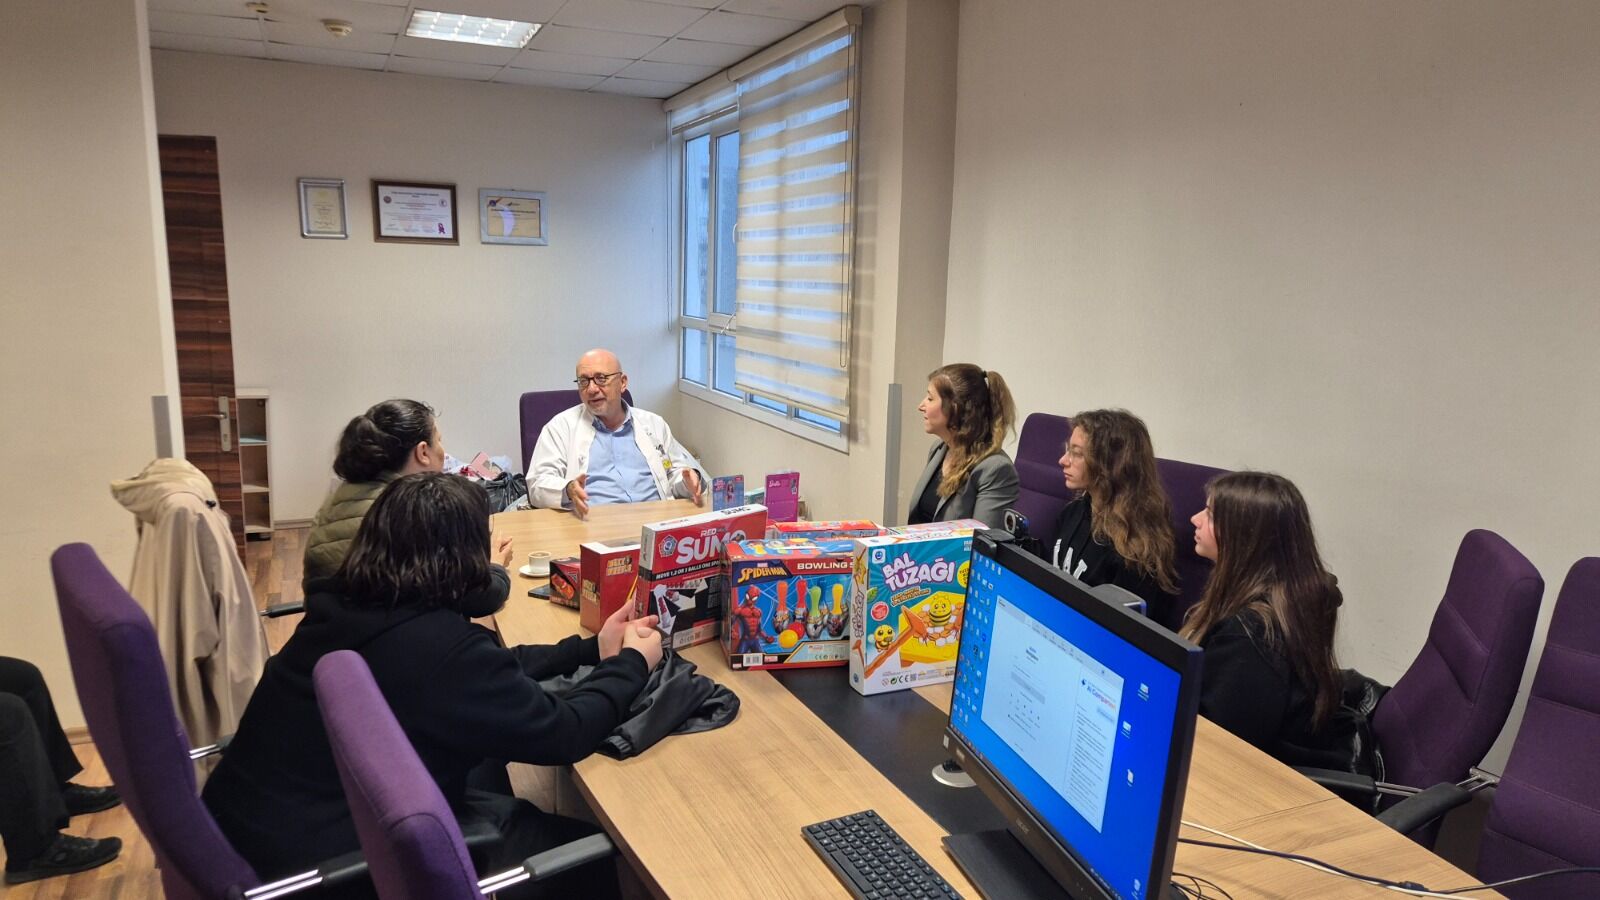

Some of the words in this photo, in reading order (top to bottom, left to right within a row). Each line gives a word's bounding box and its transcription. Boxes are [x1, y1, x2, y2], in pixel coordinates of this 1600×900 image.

[700, 528, 717, 537] RED
[797, 561, 848, 570] BOWLING
[882, 552, 915, 579] BAL
[656, 572, 670, 580] MOVE
[886, 557, 956, 591] TUZAĞI
